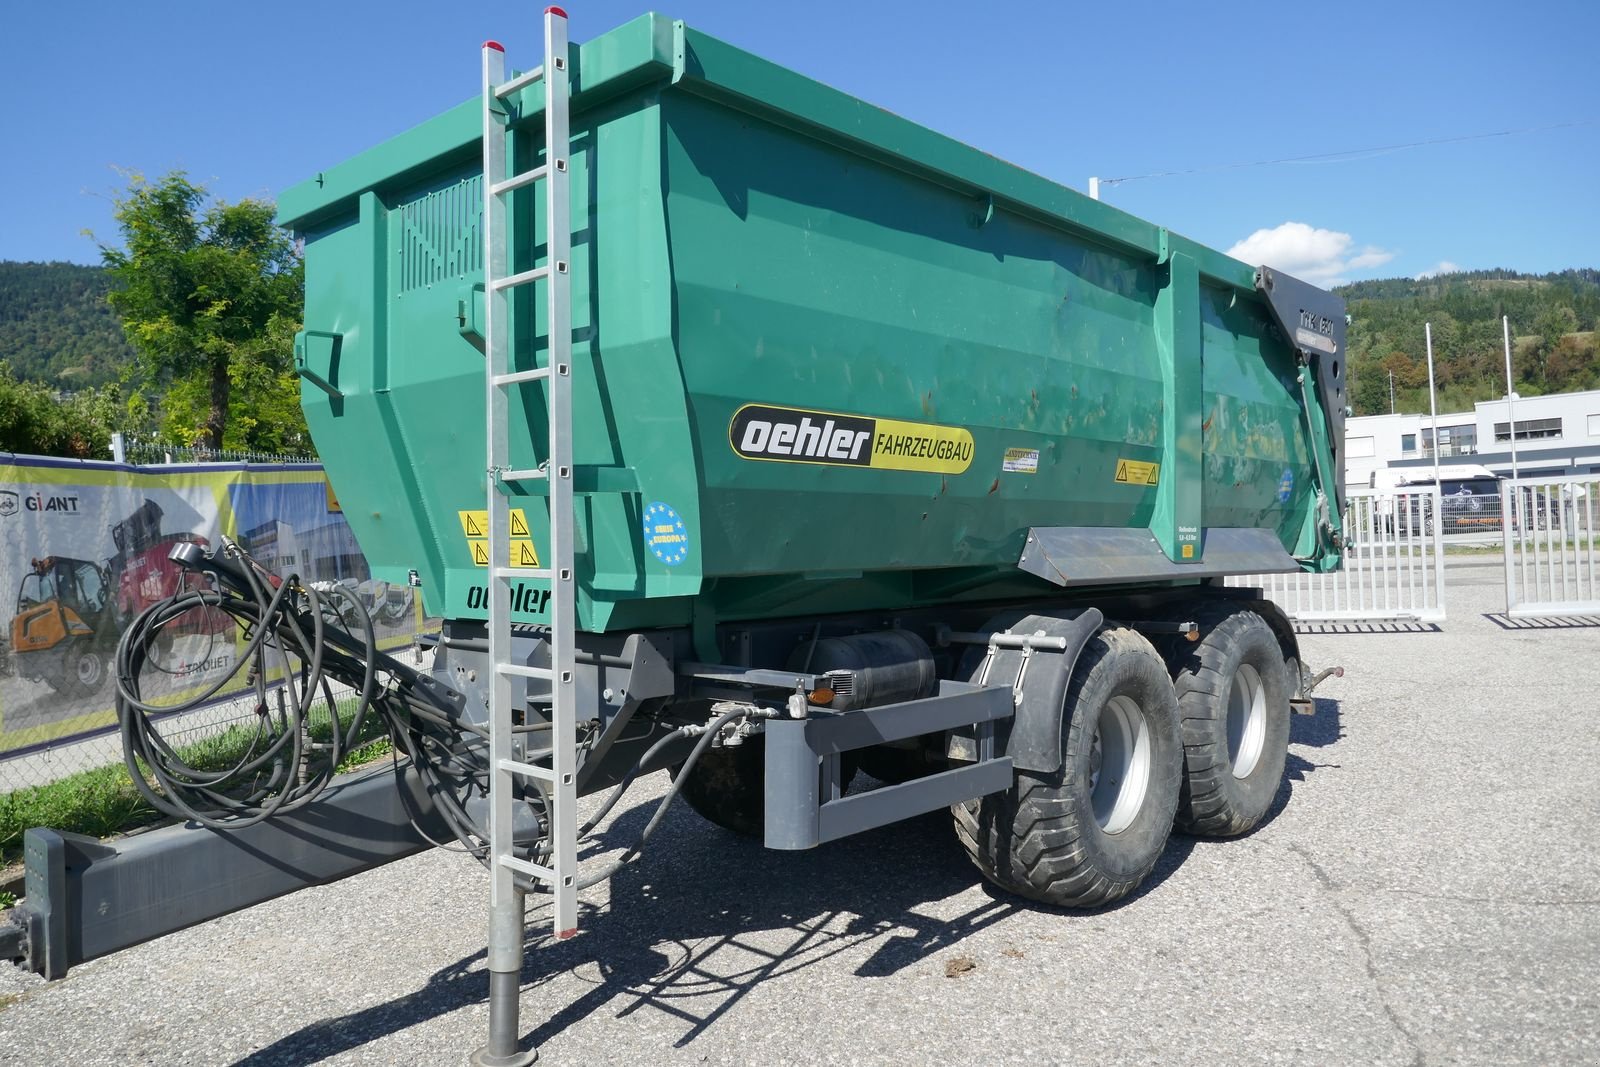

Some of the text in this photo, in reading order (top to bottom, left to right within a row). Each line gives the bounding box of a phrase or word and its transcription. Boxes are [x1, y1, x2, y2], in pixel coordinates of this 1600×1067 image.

[741, 417, 973, 462] oehler FAHRZEUGBAU
[653, 534, 681, 544] EUROPA
